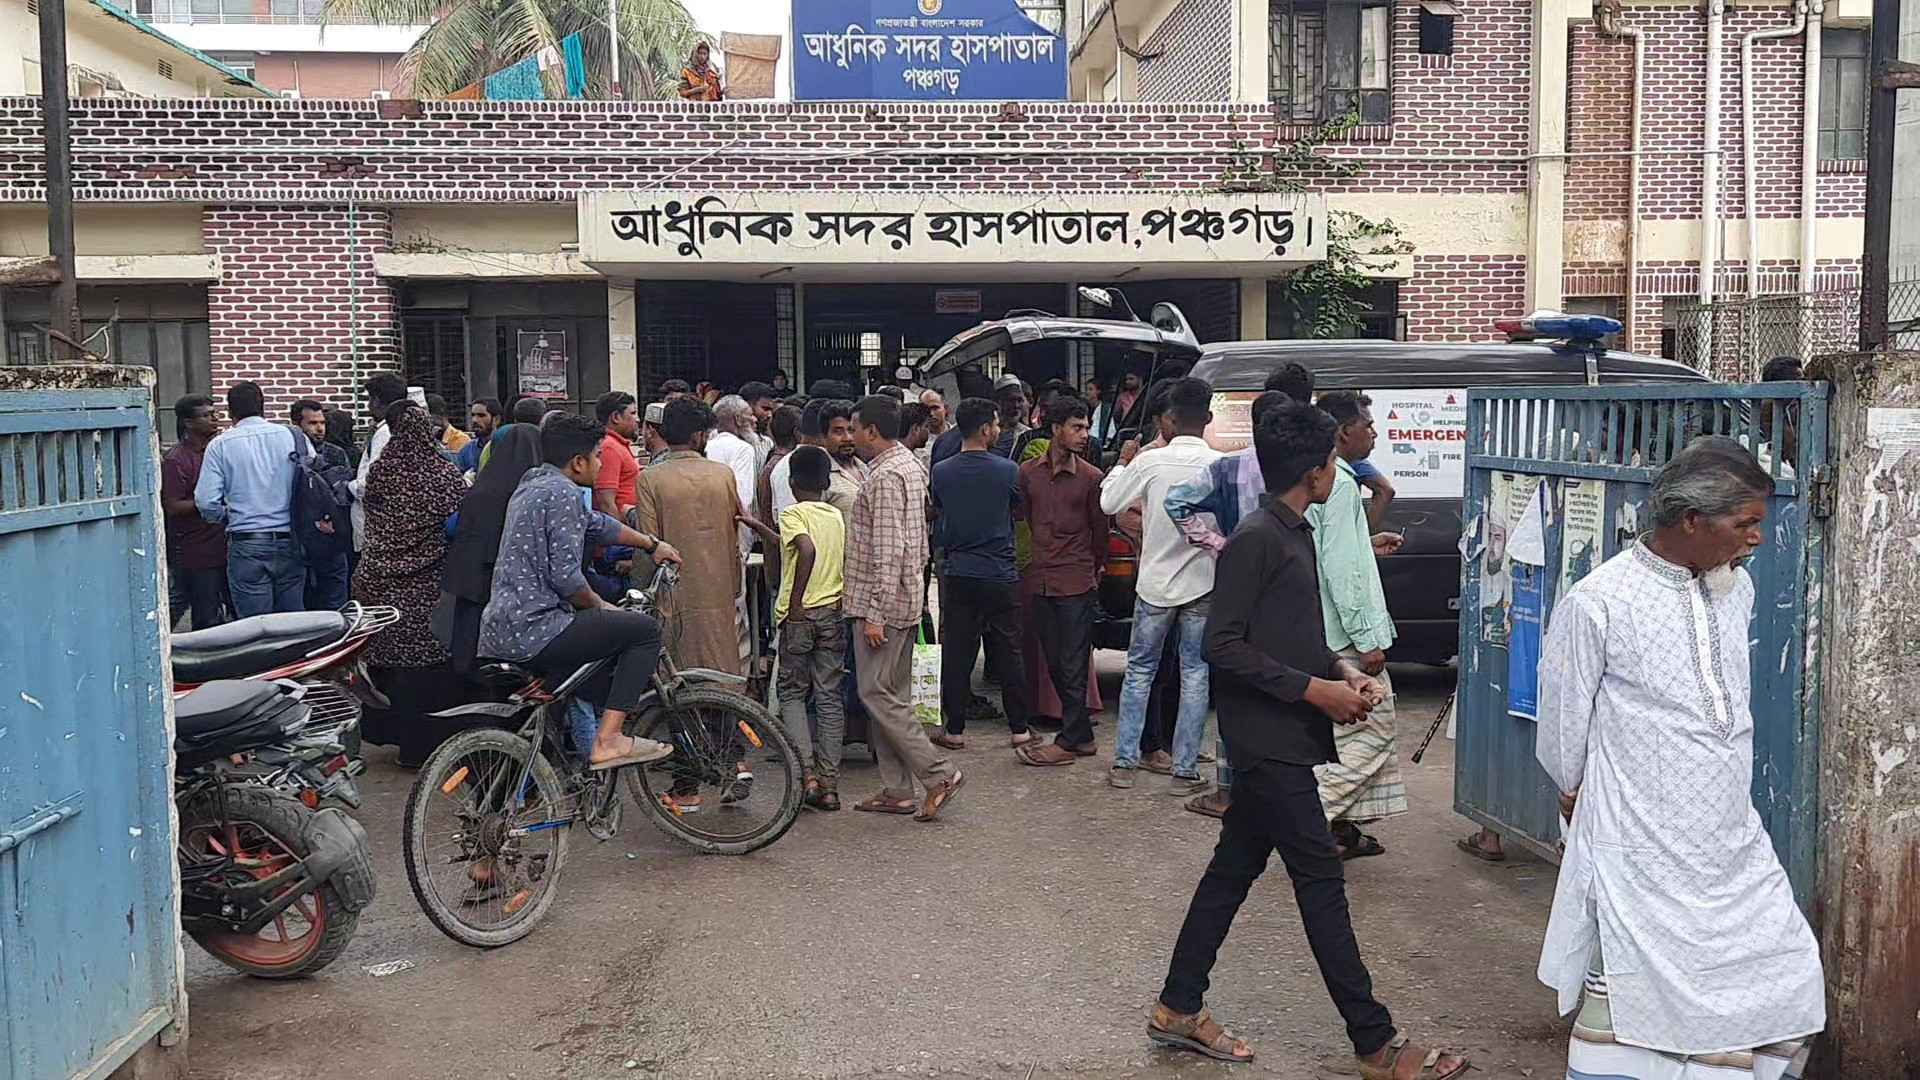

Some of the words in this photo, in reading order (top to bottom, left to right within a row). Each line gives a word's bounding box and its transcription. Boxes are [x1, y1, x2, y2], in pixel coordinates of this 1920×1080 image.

[803, 24, 888, 69] আধুনিক
[893, 34, 943, 62] সদর
[948, 33, 1056, 65] হাসপাতাল
[903, 67, 961, 95] পঞ্চগড়
[610, 196, 794, 259] আধুনিক
[805, 211, 914, 250] সদর
[1388, 428, 1491, 441] EMERGEN
